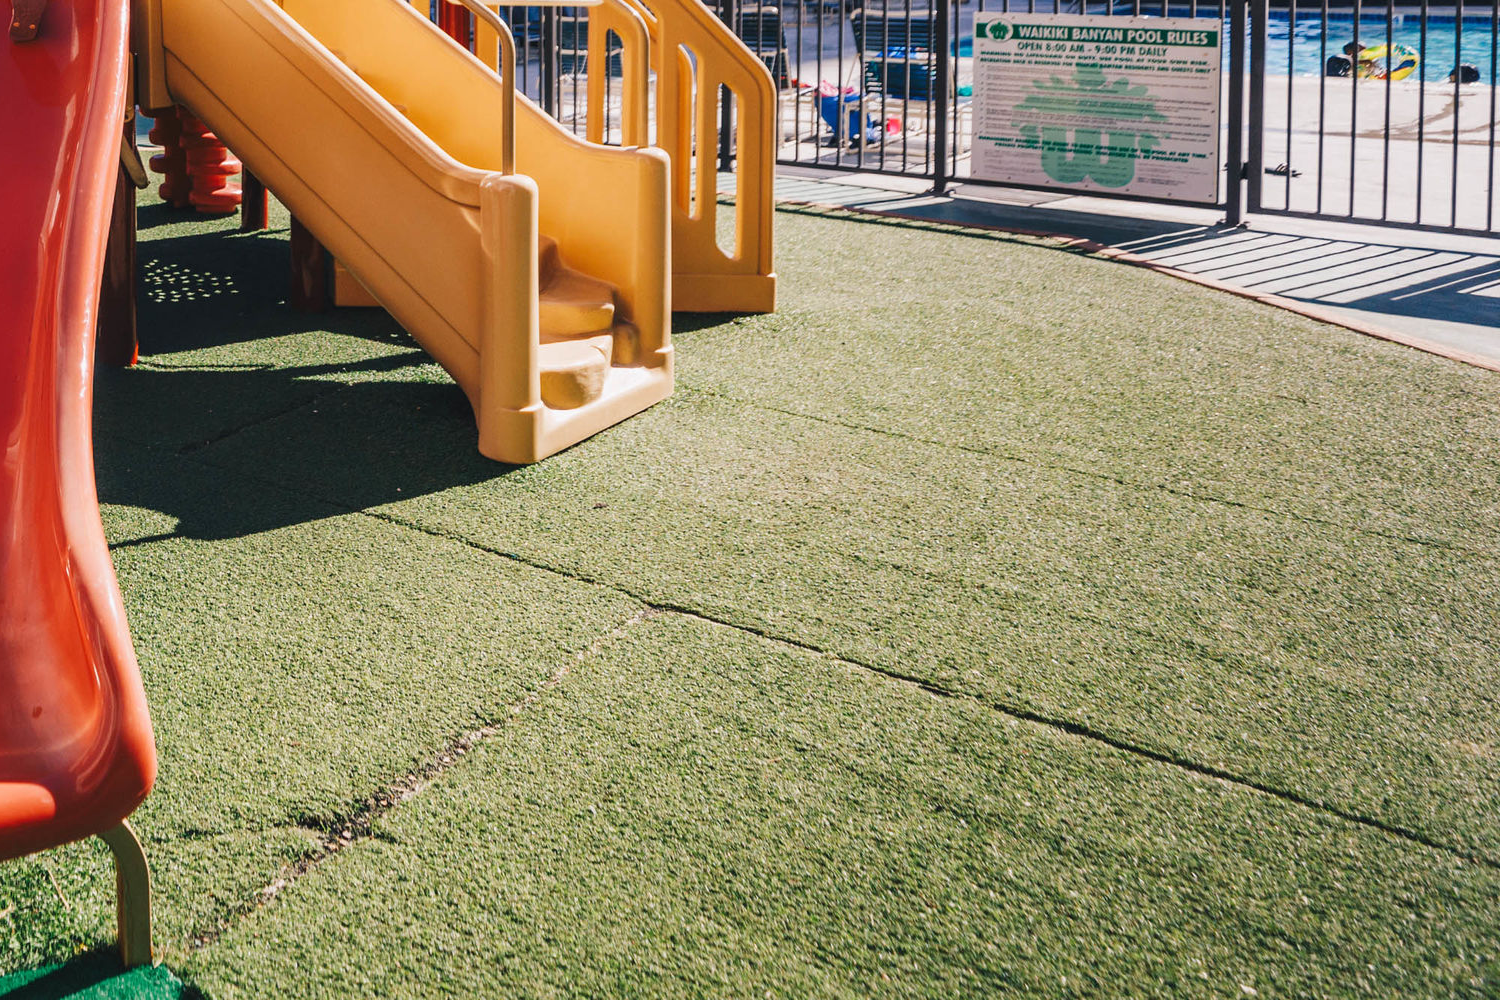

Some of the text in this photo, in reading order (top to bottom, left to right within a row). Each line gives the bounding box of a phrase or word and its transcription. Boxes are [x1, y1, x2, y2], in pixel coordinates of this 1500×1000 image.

[1018, 26, 1207, 44] WAIKIKI BANYAN POOL RULES
[1017, 41, 1042, 50] OPEN
[1045, 42, 1066, 52] 8:00
[1069, 43, 1084, 52] AM
[1094, 44, 1116, 54] 9:00
[1120, 45, 1135, 55] PM
[1138, 46, 1167, 56] DAILY
